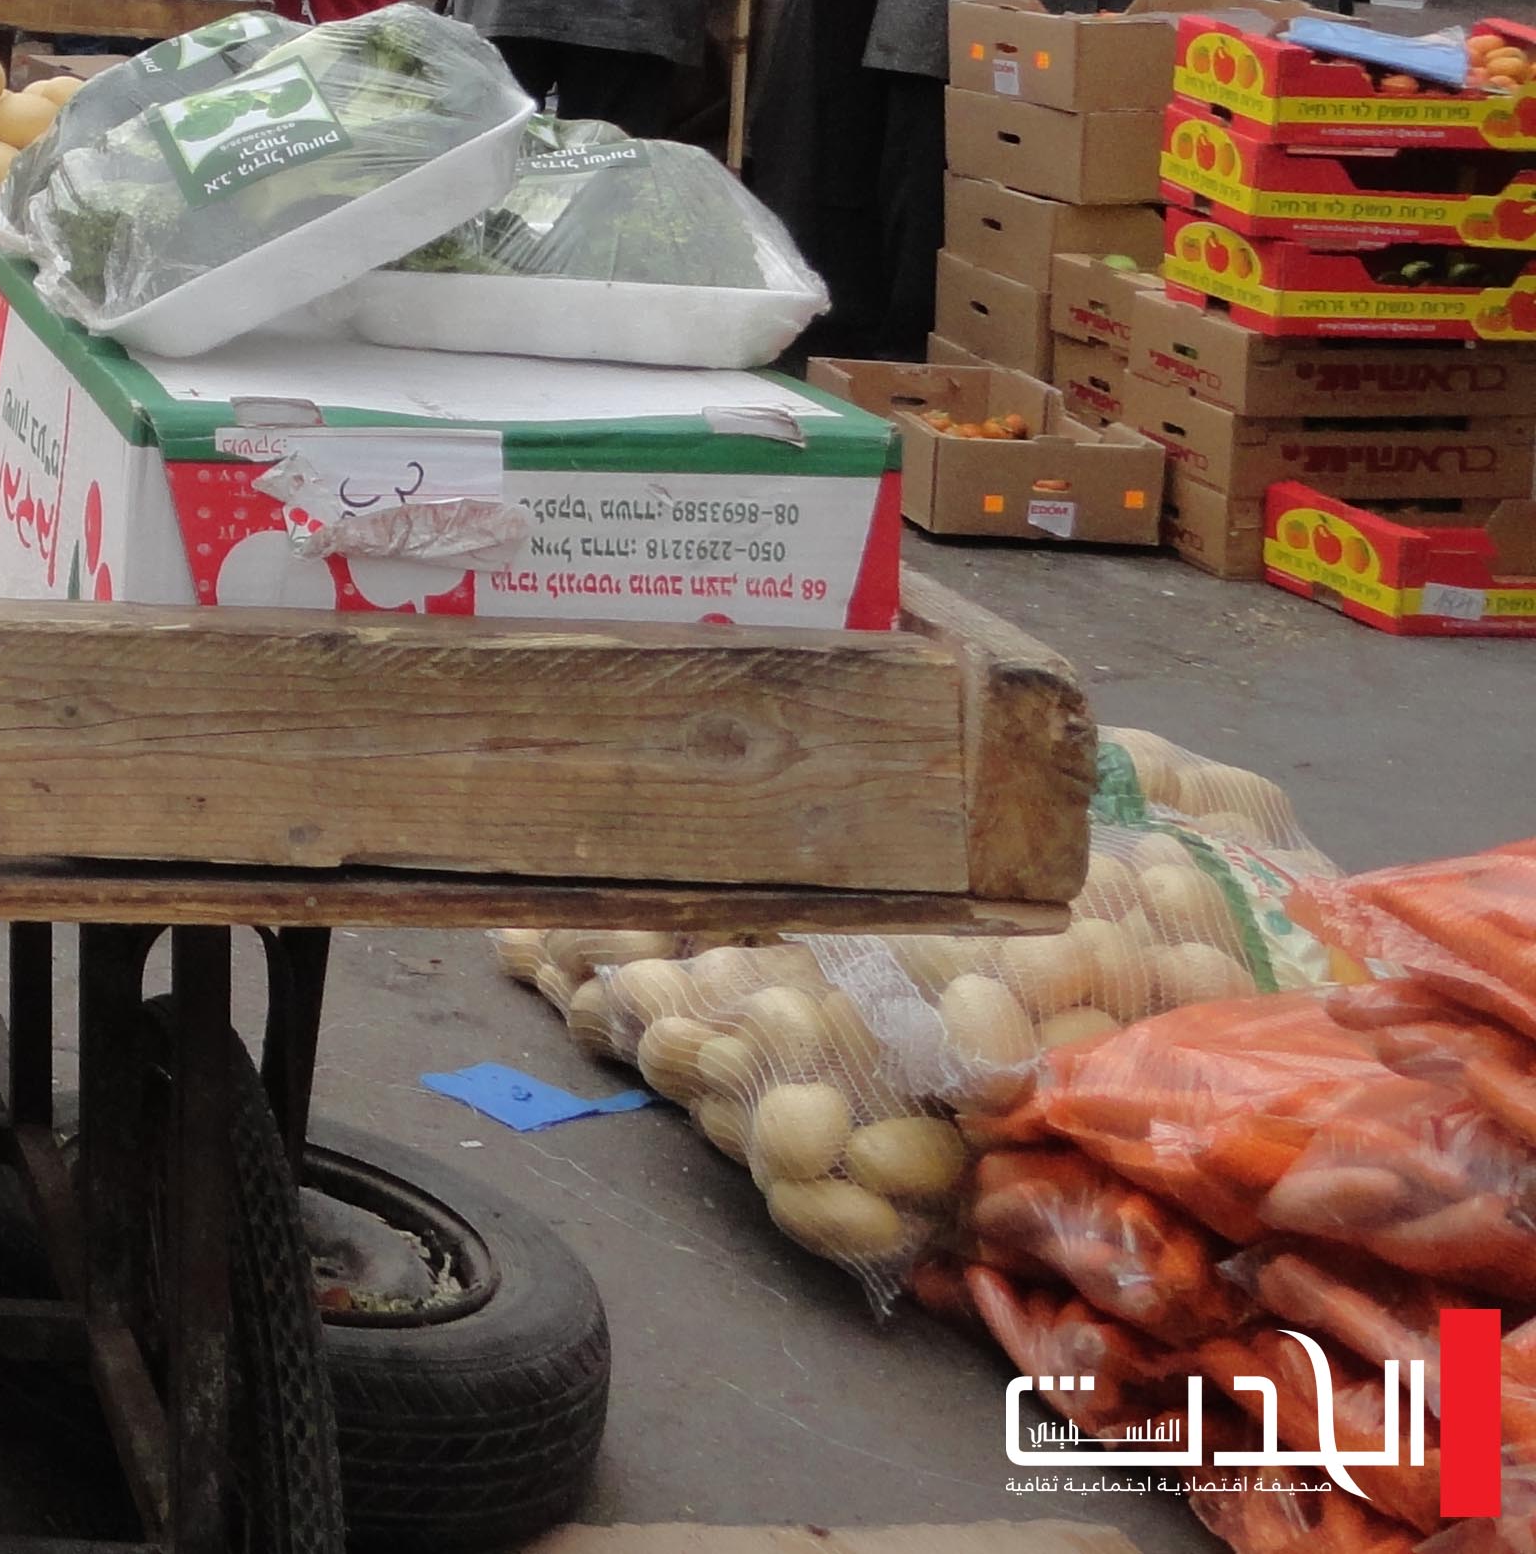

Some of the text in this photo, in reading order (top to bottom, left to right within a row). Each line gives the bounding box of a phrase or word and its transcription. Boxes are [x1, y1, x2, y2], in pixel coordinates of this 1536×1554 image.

[239, 133, 289, 160] ירקות
[599, 498, 665, 523] משרד:
[671, 500, 800, 527] 08-8693589
[530, 535, 787, 563] אייל ברדה: 050-2293218
[544, 571, 622, 598] לוגיסטי
[629, 573, 684, 596] מושב
[745, 572, 794, 598] משק
[801, 577, 827, 601] 68
